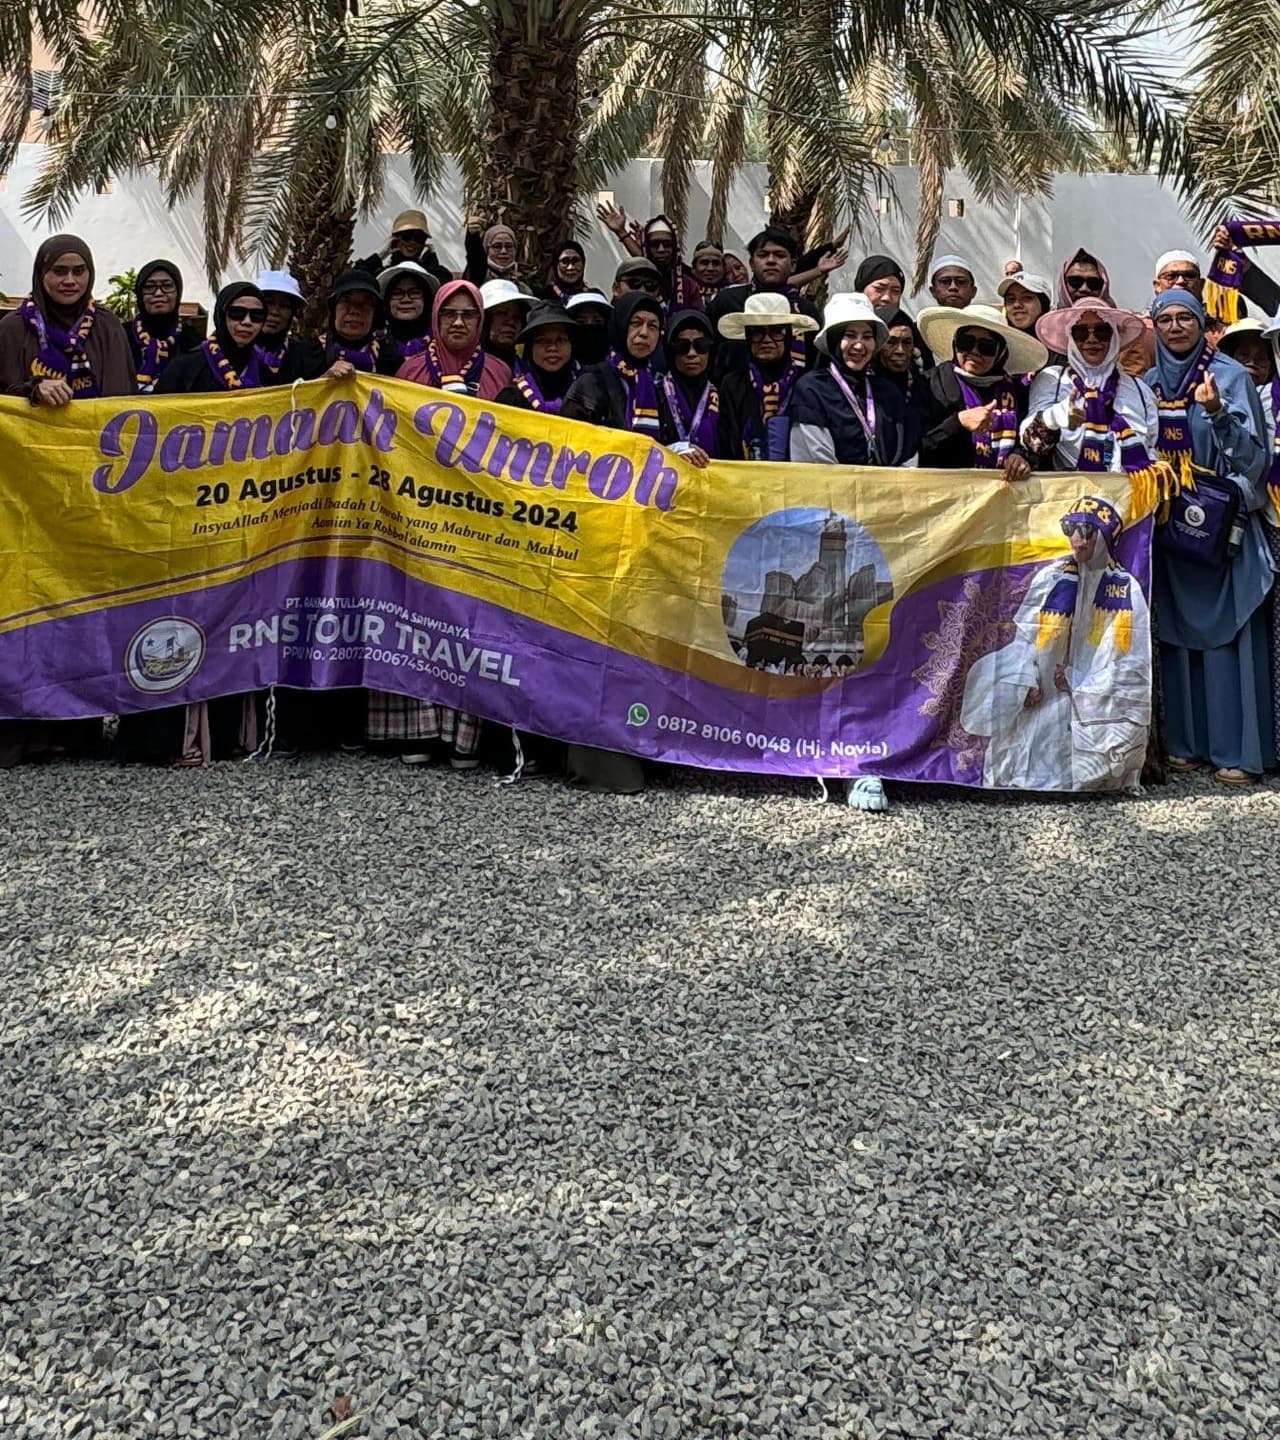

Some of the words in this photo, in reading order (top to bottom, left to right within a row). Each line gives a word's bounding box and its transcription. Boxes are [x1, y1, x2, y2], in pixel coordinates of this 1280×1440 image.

[93, 389, 397, 494] Jamaah
[414, 401, 679, 511] Umroh
[192, 513, 269, 536] InsyaAllah
[272, 498, 320, 520] Menjadi
[406, 515, 438, 533] yang
[441, 520, 493, 543] Mabrur
[494, 533, 520, 549] dan
[525, 539, 579, 561] Makbul
[196, 482, 230, 507] 20
[238, 465, 342, 502] Agustus
[369, 464, 391, 491] 28
[397, 476, 505, 517] Agustus
[512, 500, 579, 533] 2024
[355, 516, 370, 530] Ya
[228, 614, 299, 653] RNS
[305, 613, 386, 645] TOUR
[394, 620, 521, 687] TRAVEL
[285, 597, 303, 610] PT.
[377, 599, 409, 623] NOVIA
[410, 611, 471, 641] SRIWIJAYA
[656, 713, 698, 736] 0812
[701, 723, 742, 745] 8106
[745, 731, 791, 754] 0048
[795, 738, 826, 759] (Hj.
[830, 740, 888, 758] Novia)
